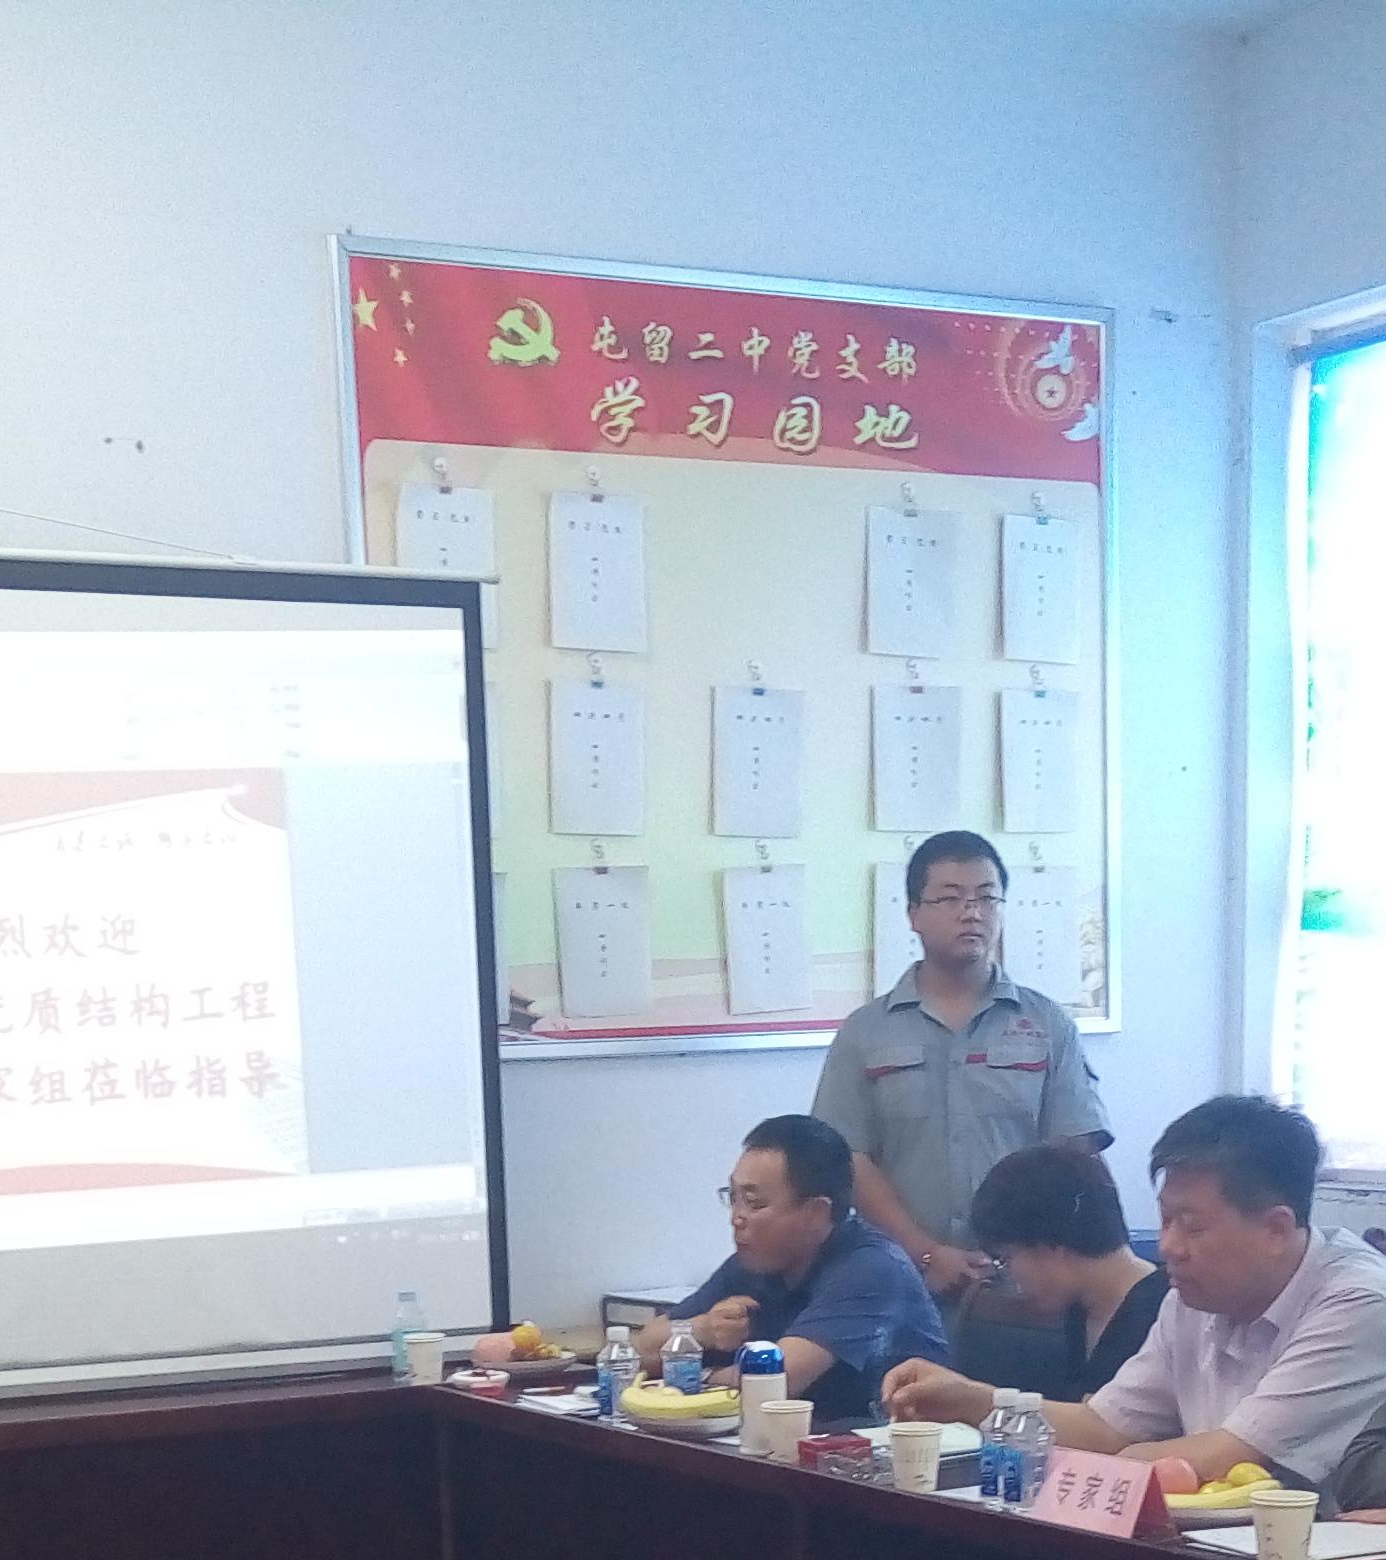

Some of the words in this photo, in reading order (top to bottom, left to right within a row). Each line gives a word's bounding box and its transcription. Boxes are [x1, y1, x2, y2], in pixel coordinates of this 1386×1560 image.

[590, 315, 919, 384] 屯留二中党支部
[589, 376, 920, 454] 学习园地
